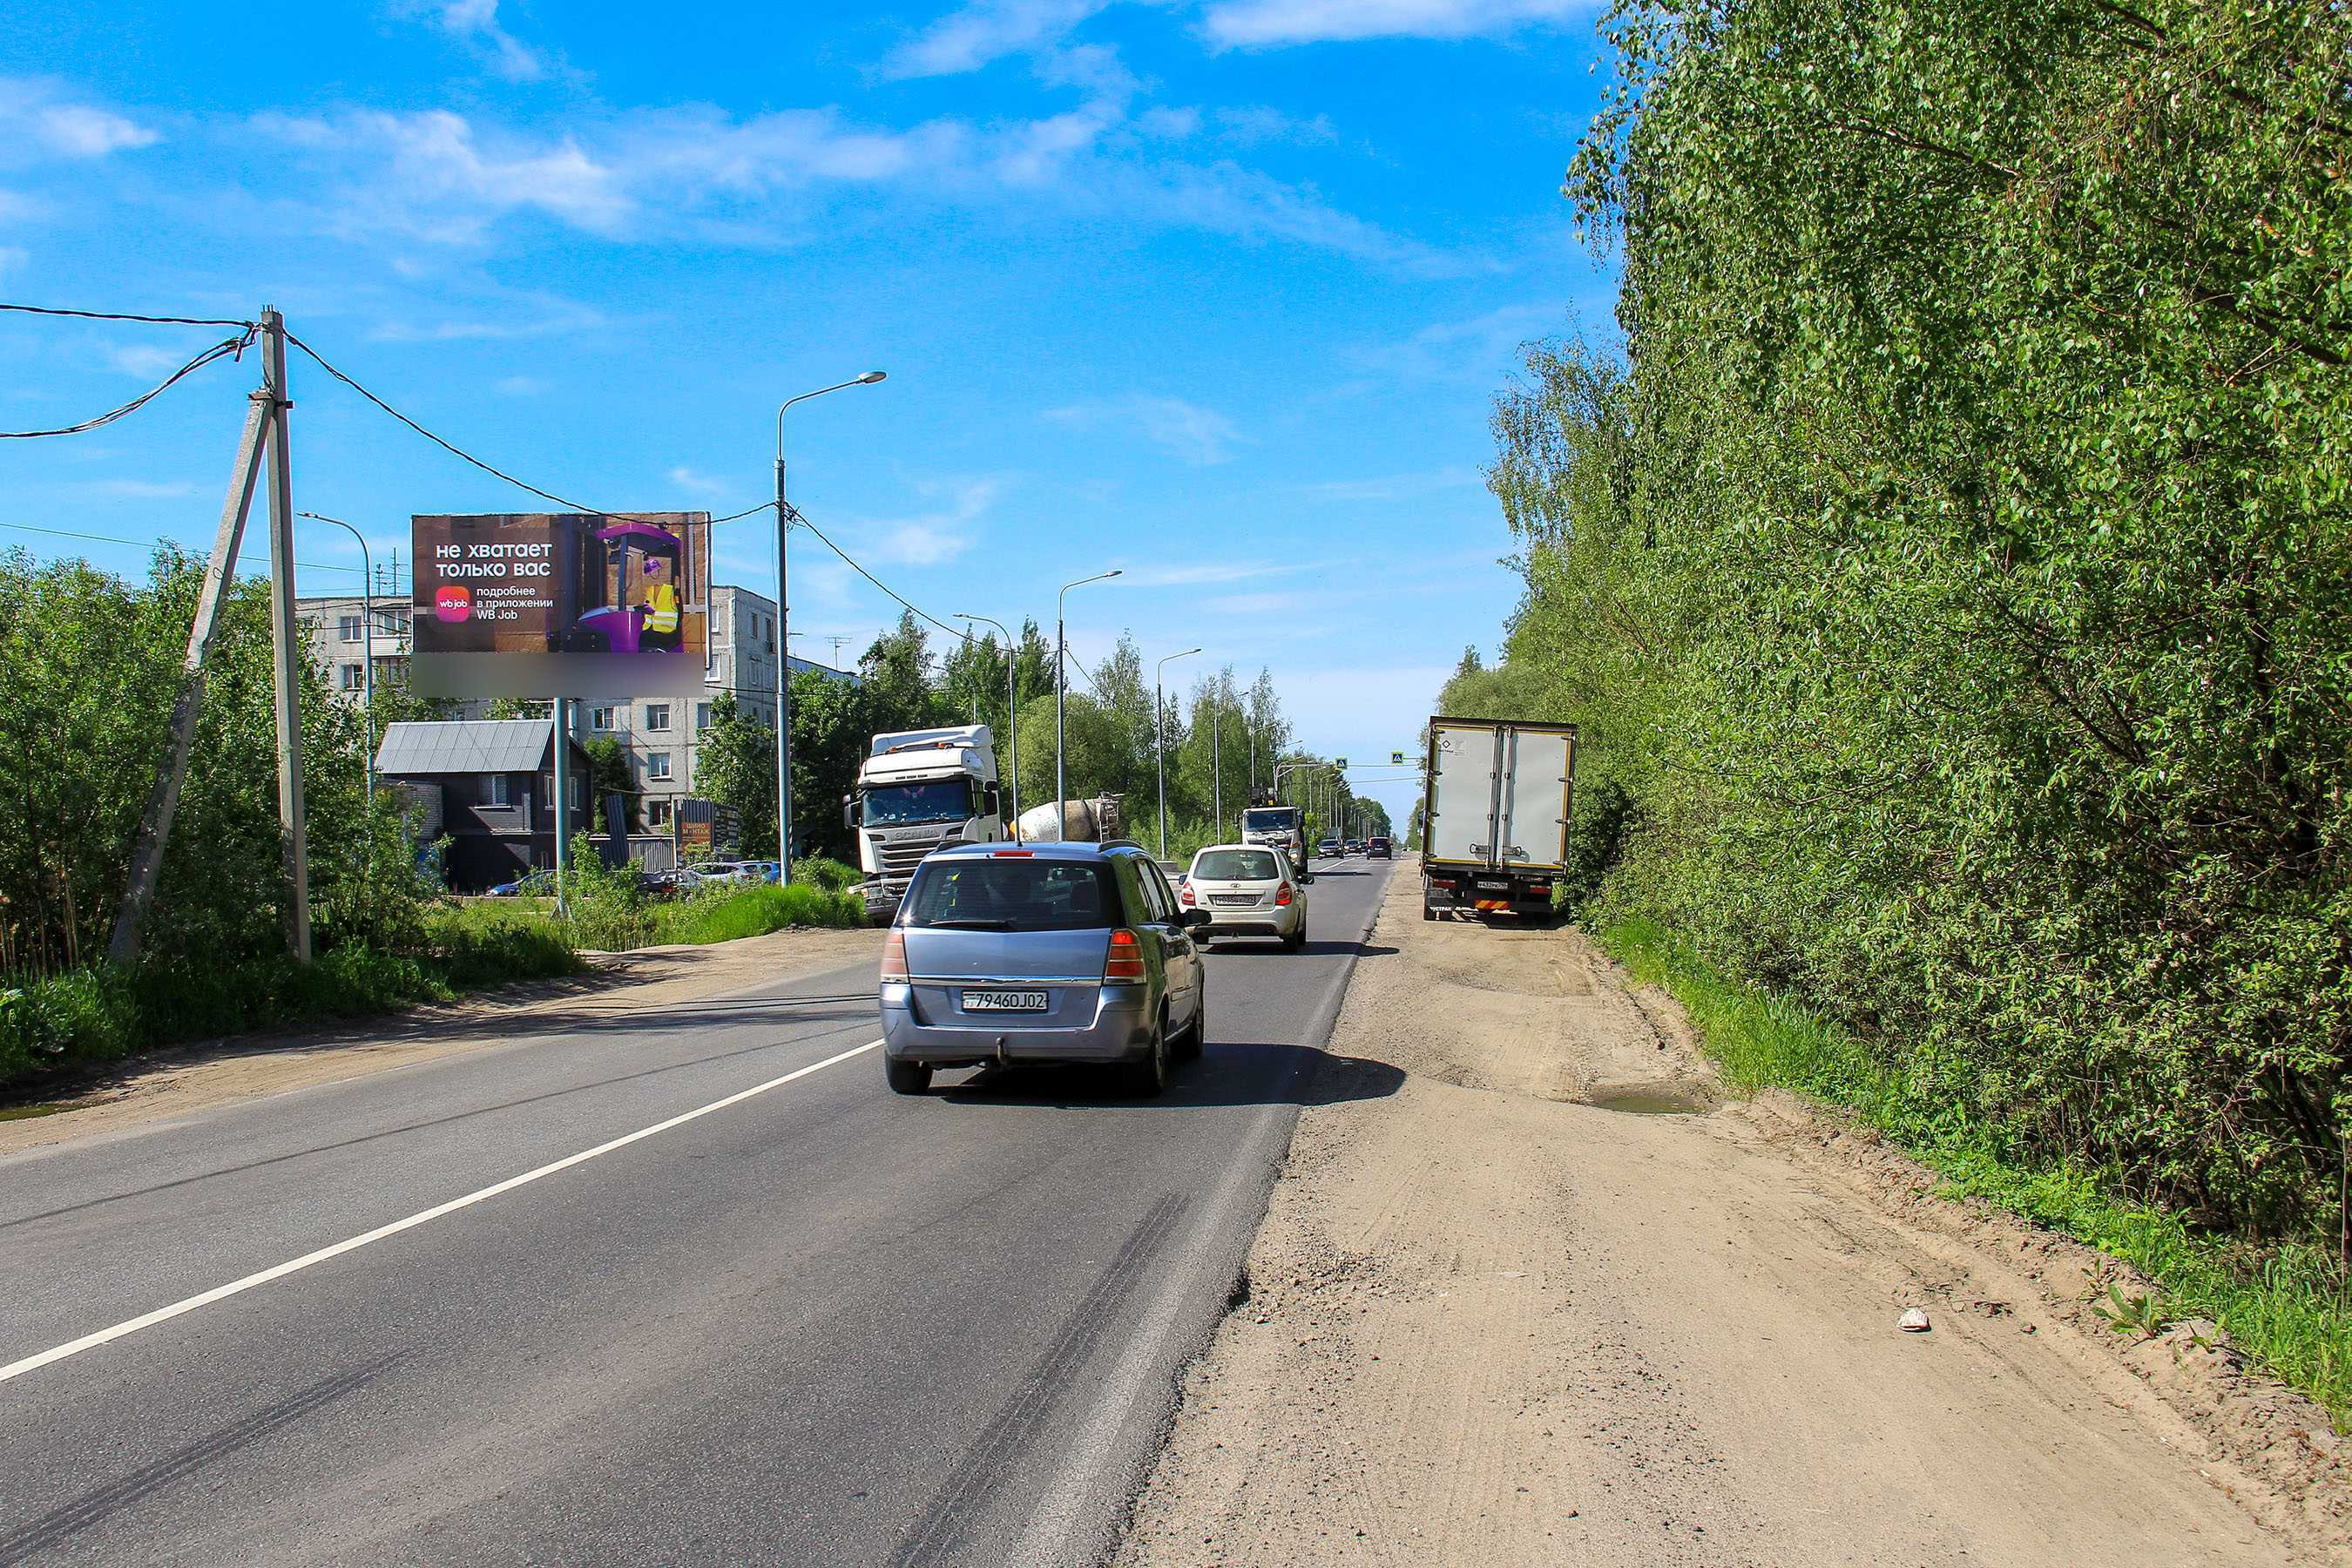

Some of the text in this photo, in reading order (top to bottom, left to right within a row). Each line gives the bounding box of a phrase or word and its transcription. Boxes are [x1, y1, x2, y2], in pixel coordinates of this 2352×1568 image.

[436, 543, 552, 558] не хватает
[436, 562, 551, 577] только вас
[476, 586, 536, 598] подробнее
[485, 599, 553, 609] приложении
[476, 610, 518, 619] WB Job
